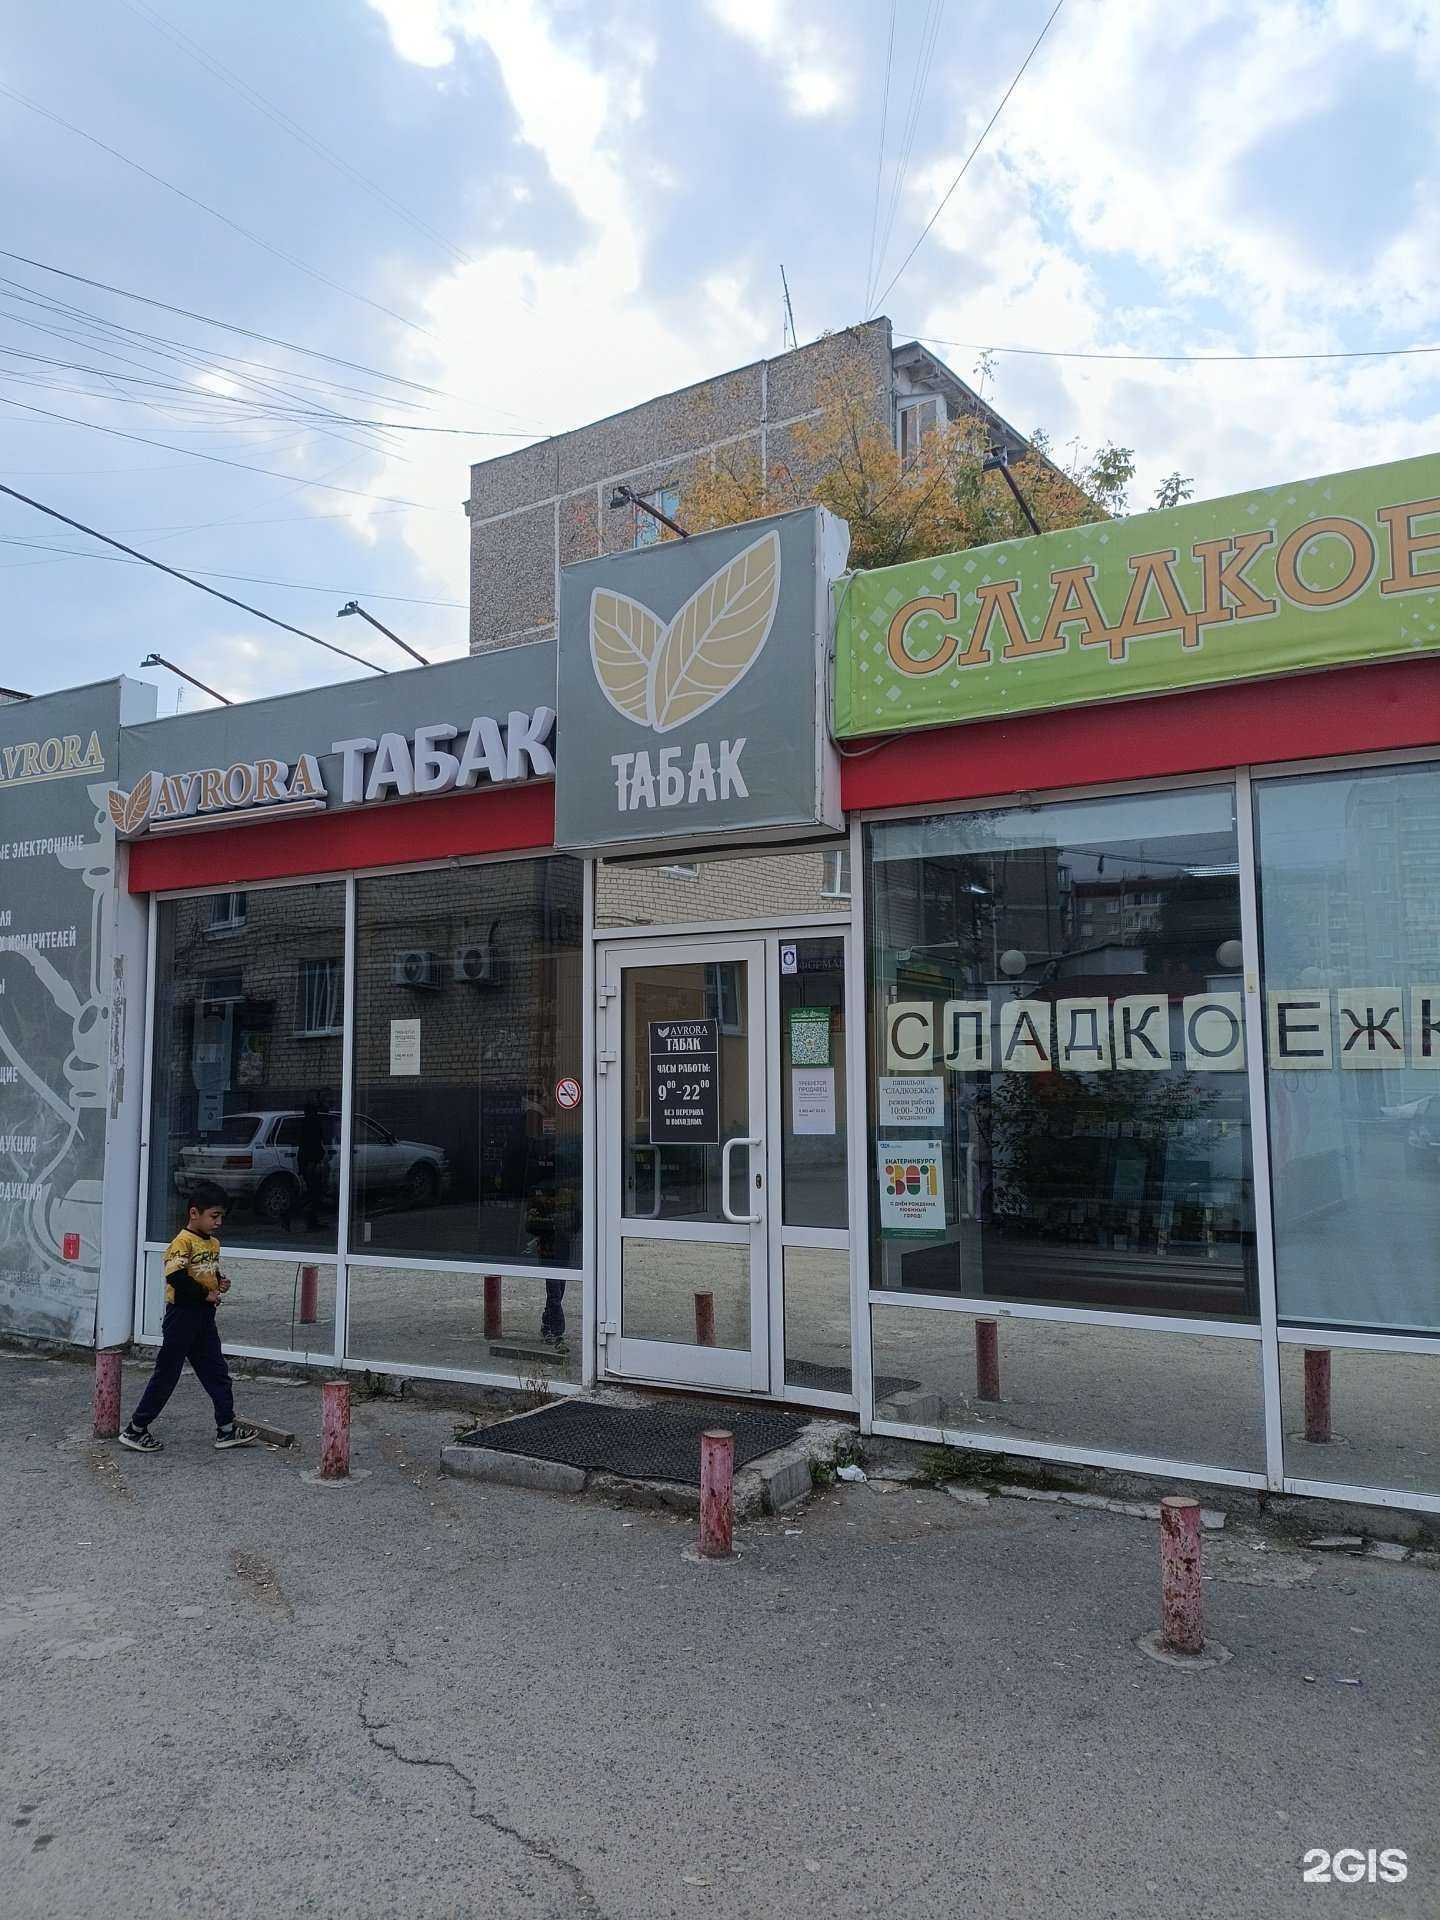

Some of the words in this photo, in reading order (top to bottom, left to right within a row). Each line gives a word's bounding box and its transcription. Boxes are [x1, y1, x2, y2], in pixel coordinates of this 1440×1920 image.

[886, 498, 1440, 676] СЛАДКОЕ
[0, 730, 104, 781] VRORA
[332, 706, 557, 803] ТАБАК
[611, 738, 750, 811] ТАБАК
[149, 753, 328, 819] AVRORA
[12, 835, 84, 858] ЭЛЕКТРОННЫЕ
[666, 1038, 701, 1050] ТАБАК
[671, 1025, 708, 1035] AVRORA
[656, 1064, 677, 1073] ЧАСЫ
[678, 1063, 711, 1073] РАБОТЫ:
